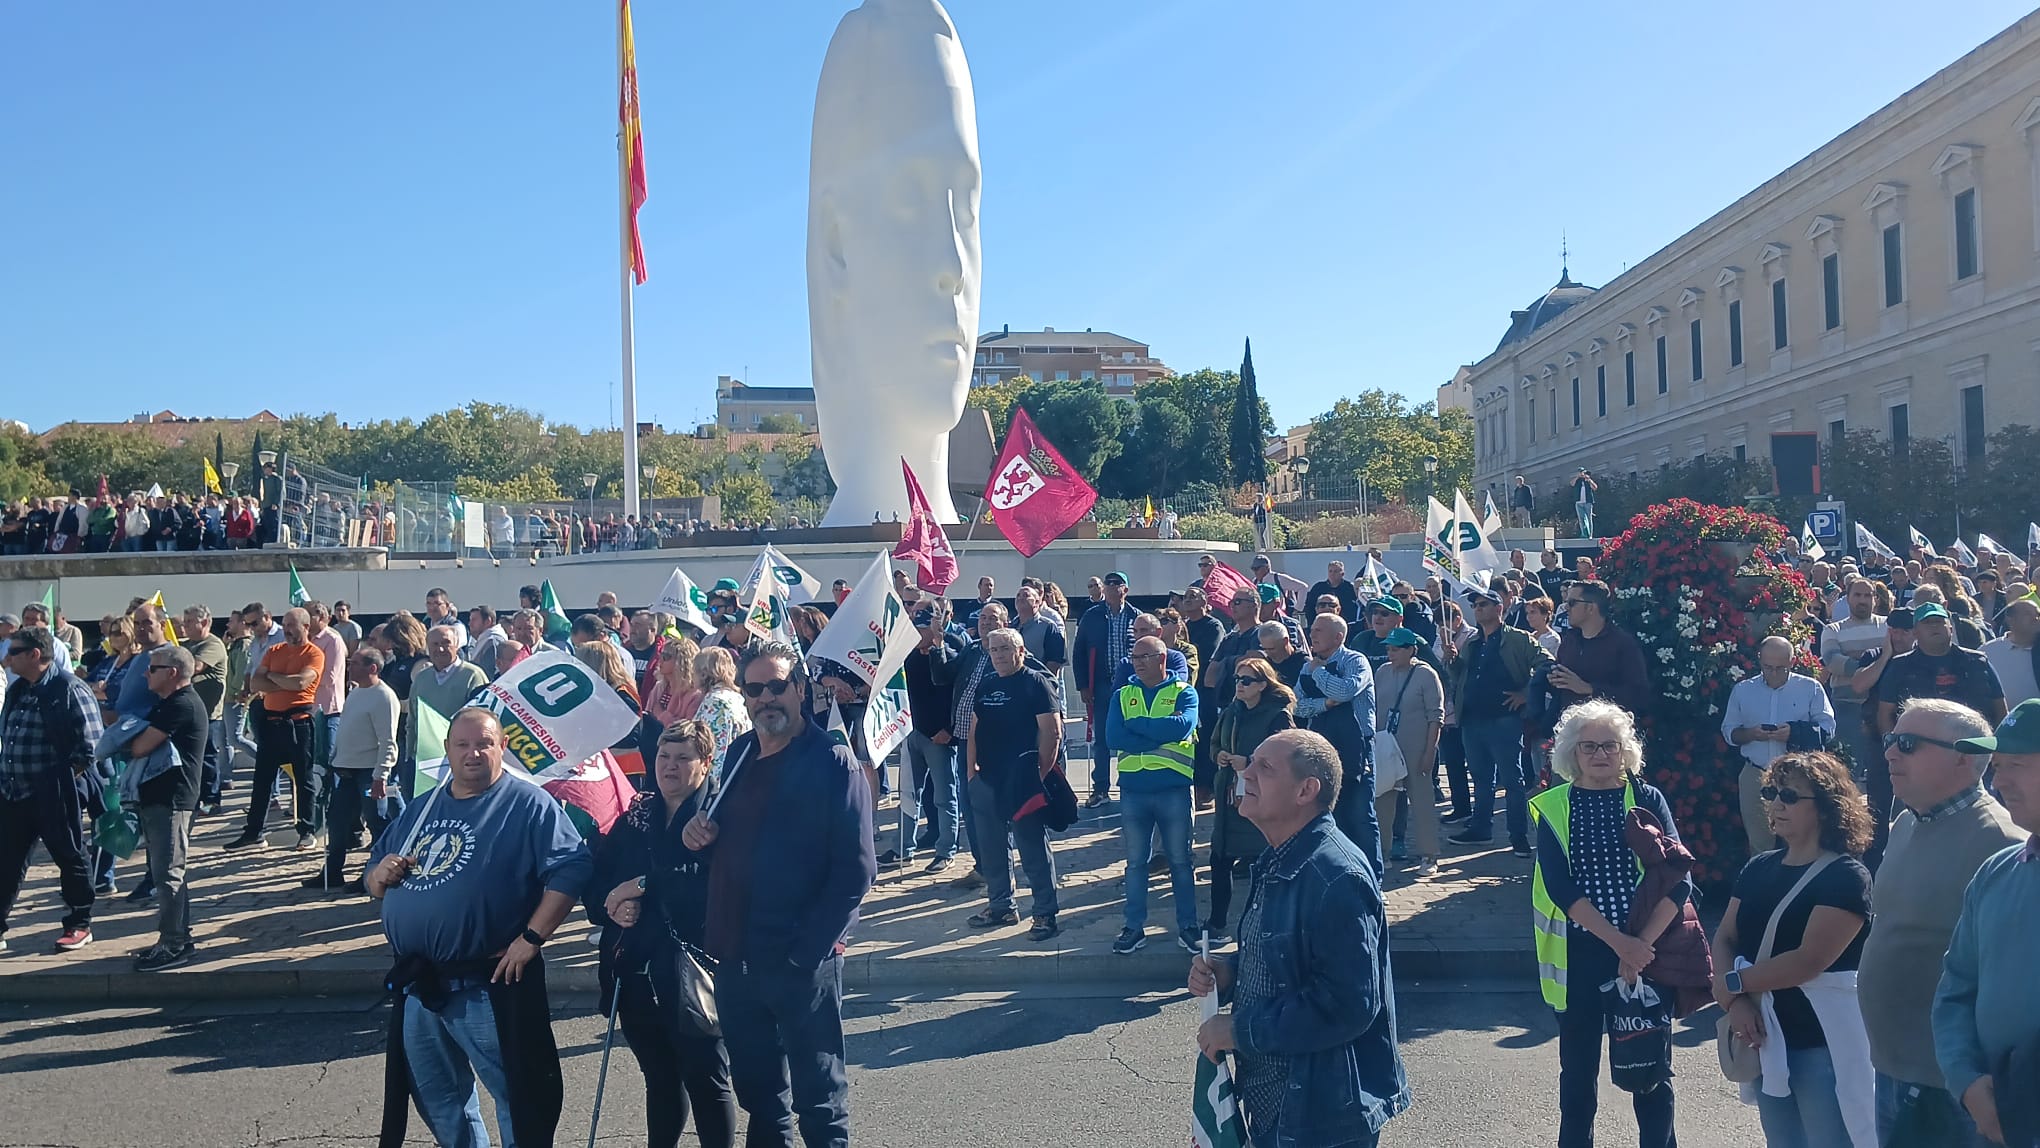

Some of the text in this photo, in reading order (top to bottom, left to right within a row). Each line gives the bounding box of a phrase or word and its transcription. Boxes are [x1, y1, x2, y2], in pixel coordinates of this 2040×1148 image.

[1814, 515, 1830, 535] P
[498, 690, 513, 704] DE
[510, 702, 567, 760] CAMPESINOS
[873, 723, 898, 750] Castilla
[897, 715, 905, 726] y
